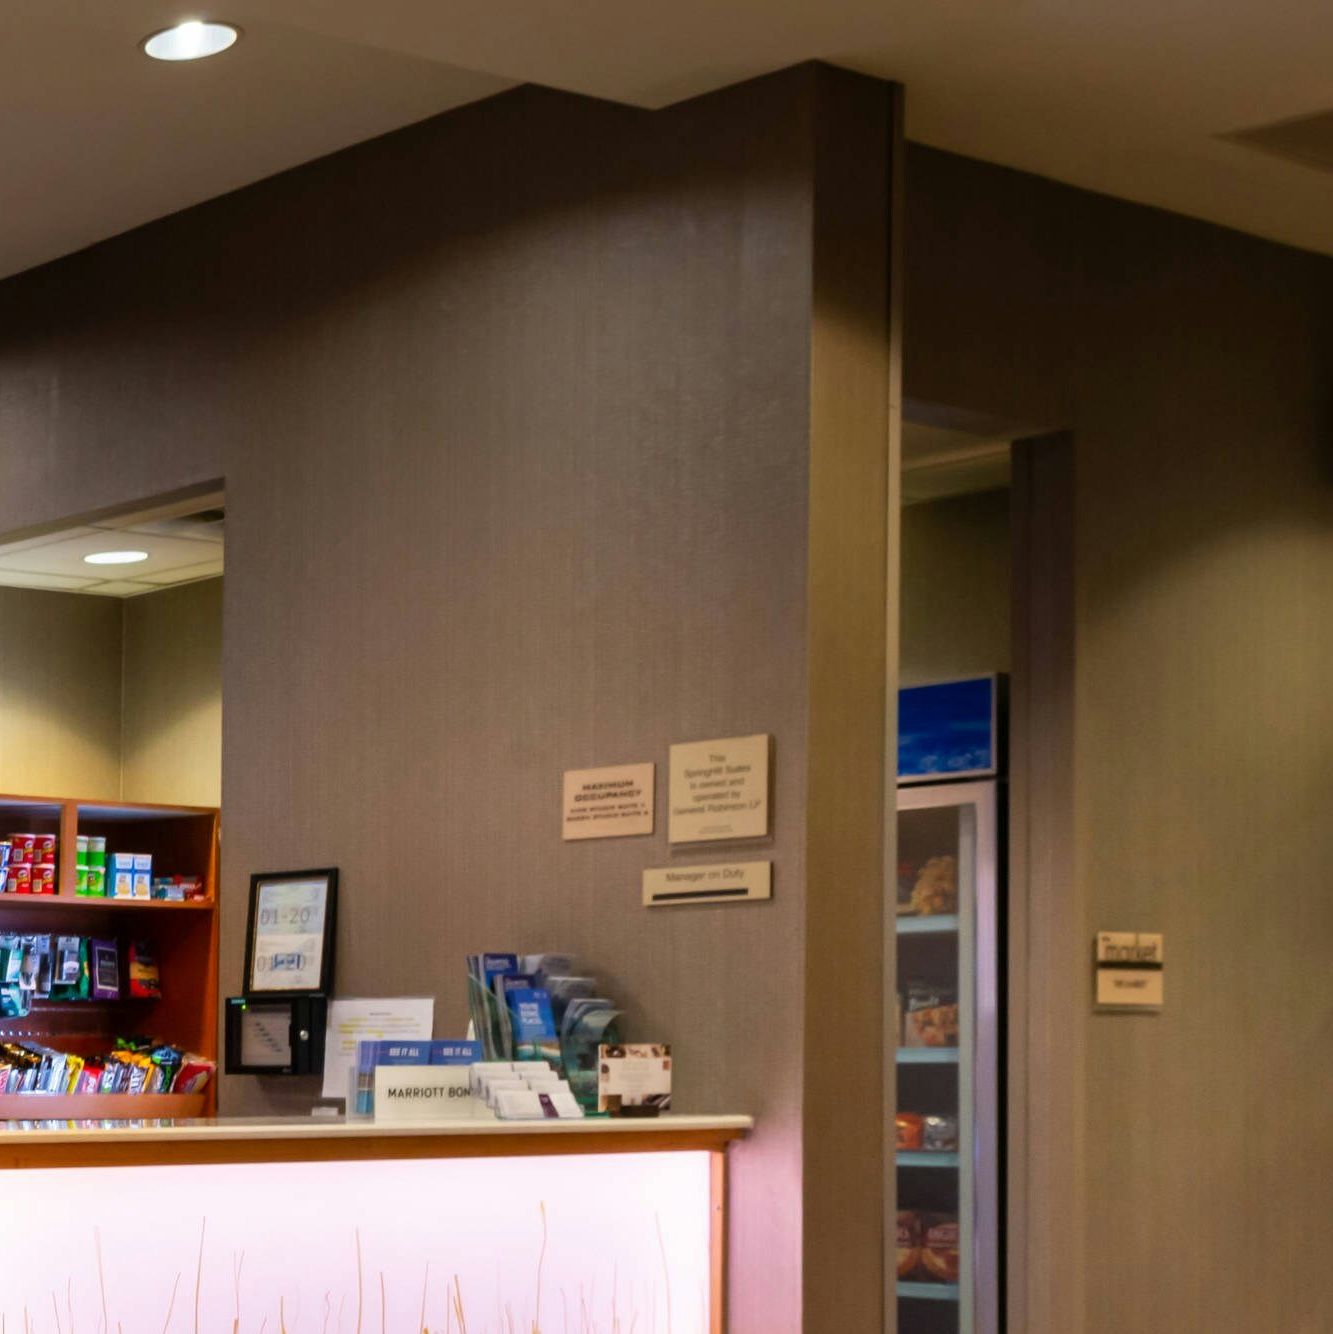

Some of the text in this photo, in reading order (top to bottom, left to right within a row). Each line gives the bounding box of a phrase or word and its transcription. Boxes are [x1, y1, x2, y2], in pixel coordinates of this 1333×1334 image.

[582, 780, 634, 791] MAXIMUM
[574, 789, 642, 802] OCCUPANCY
[388, 1087, 445, 1099] MARRIOTT
